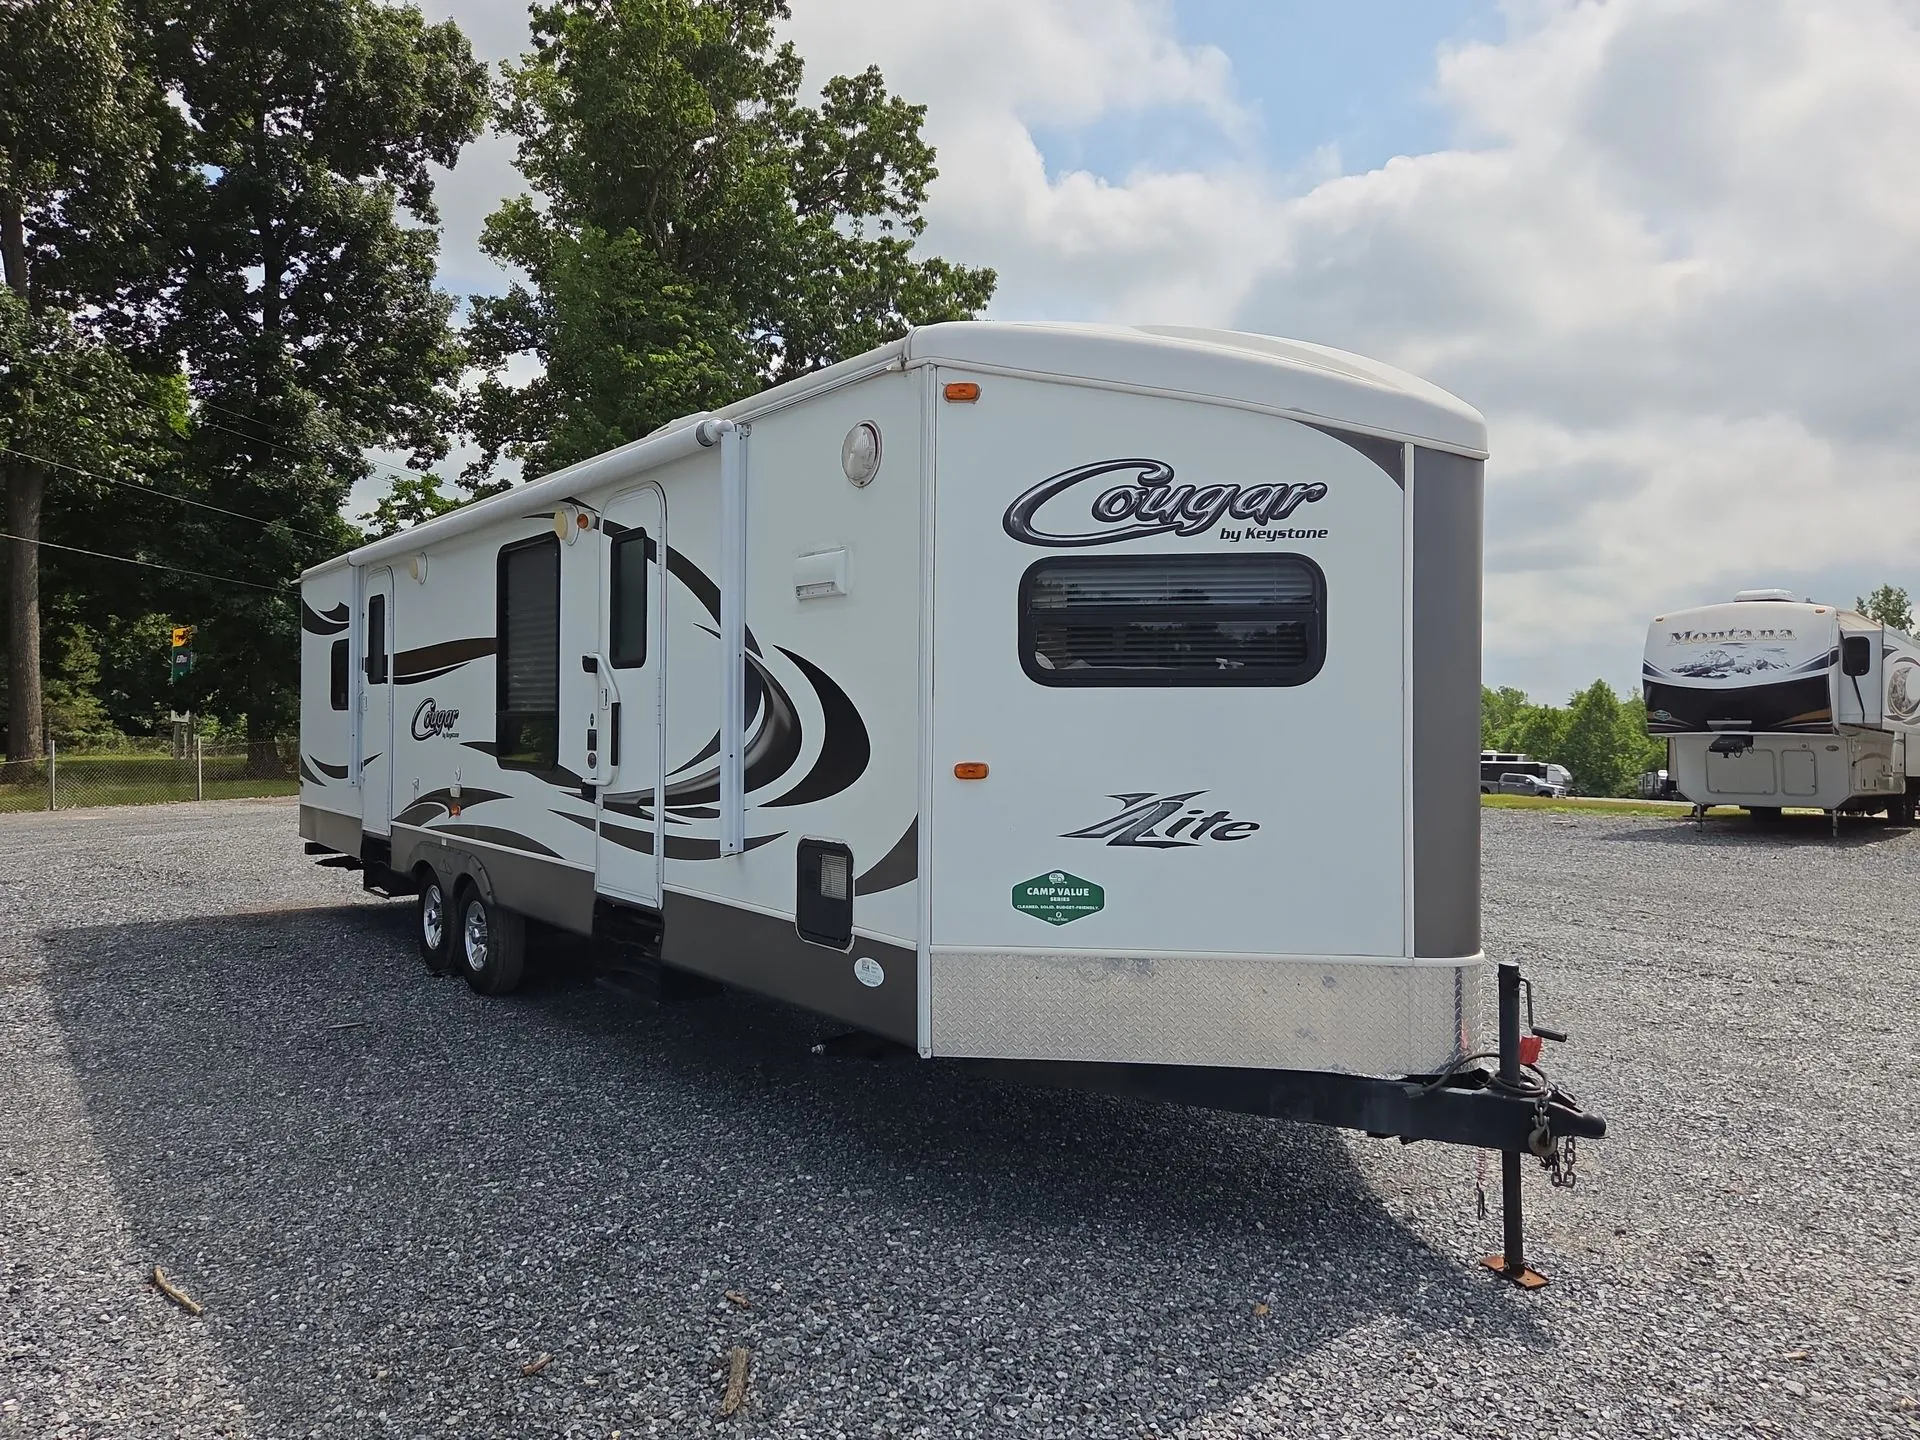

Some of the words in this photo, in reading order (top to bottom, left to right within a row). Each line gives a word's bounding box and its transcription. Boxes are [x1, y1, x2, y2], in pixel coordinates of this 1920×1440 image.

[1003, 458, 1327, 547] Cougar
[1220, 527, 1242, 542] by
[1245, 527, 1328, 542] Keystone
[1670, 628, 1797, 645] Montana
[411, 697, 459, 741] Cougar
[1027, 888, 1055, 896] CAMP
[1057, 888, 1089, 896] VALUE
